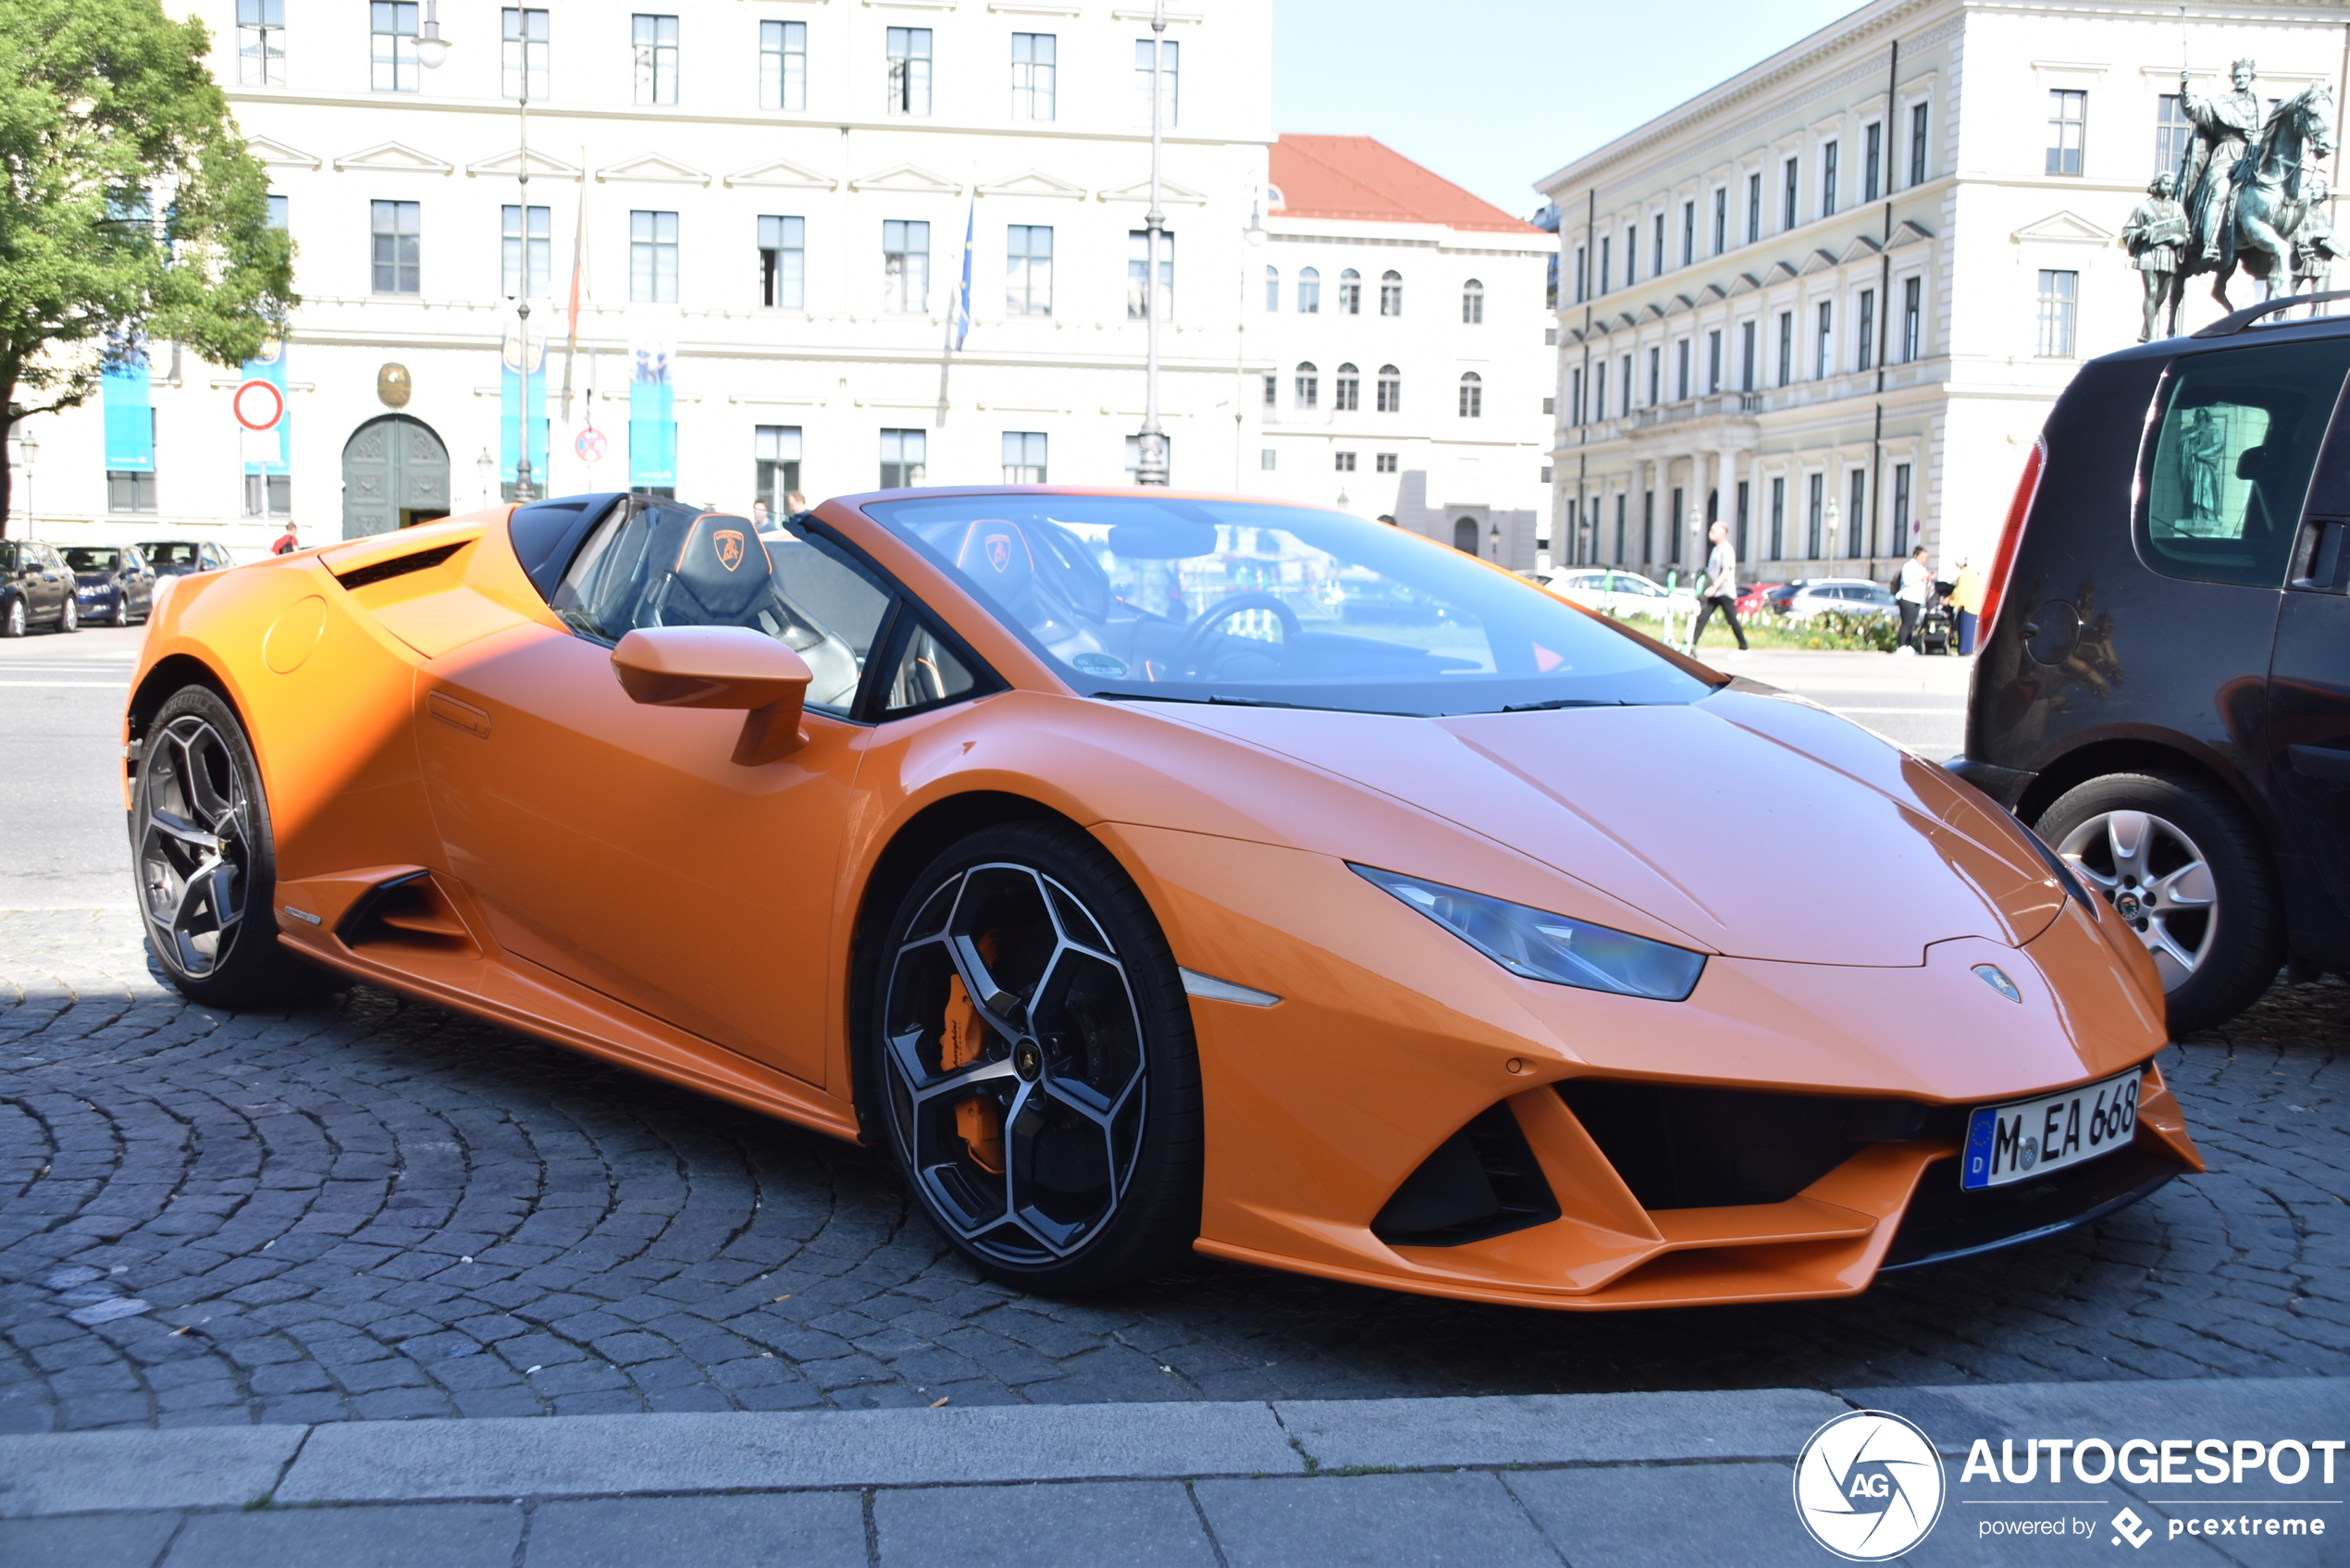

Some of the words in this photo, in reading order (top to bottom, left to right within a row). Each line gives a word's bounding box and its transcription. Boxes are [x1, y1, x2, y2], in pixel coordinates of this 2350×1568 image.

[1992, 1114, 2022, 1175] M
[2040, 1098, 2080, 1162] EA
[2088, 1079, 2137, 1145] 668
[1973, 1156, 1983, 1173] D
